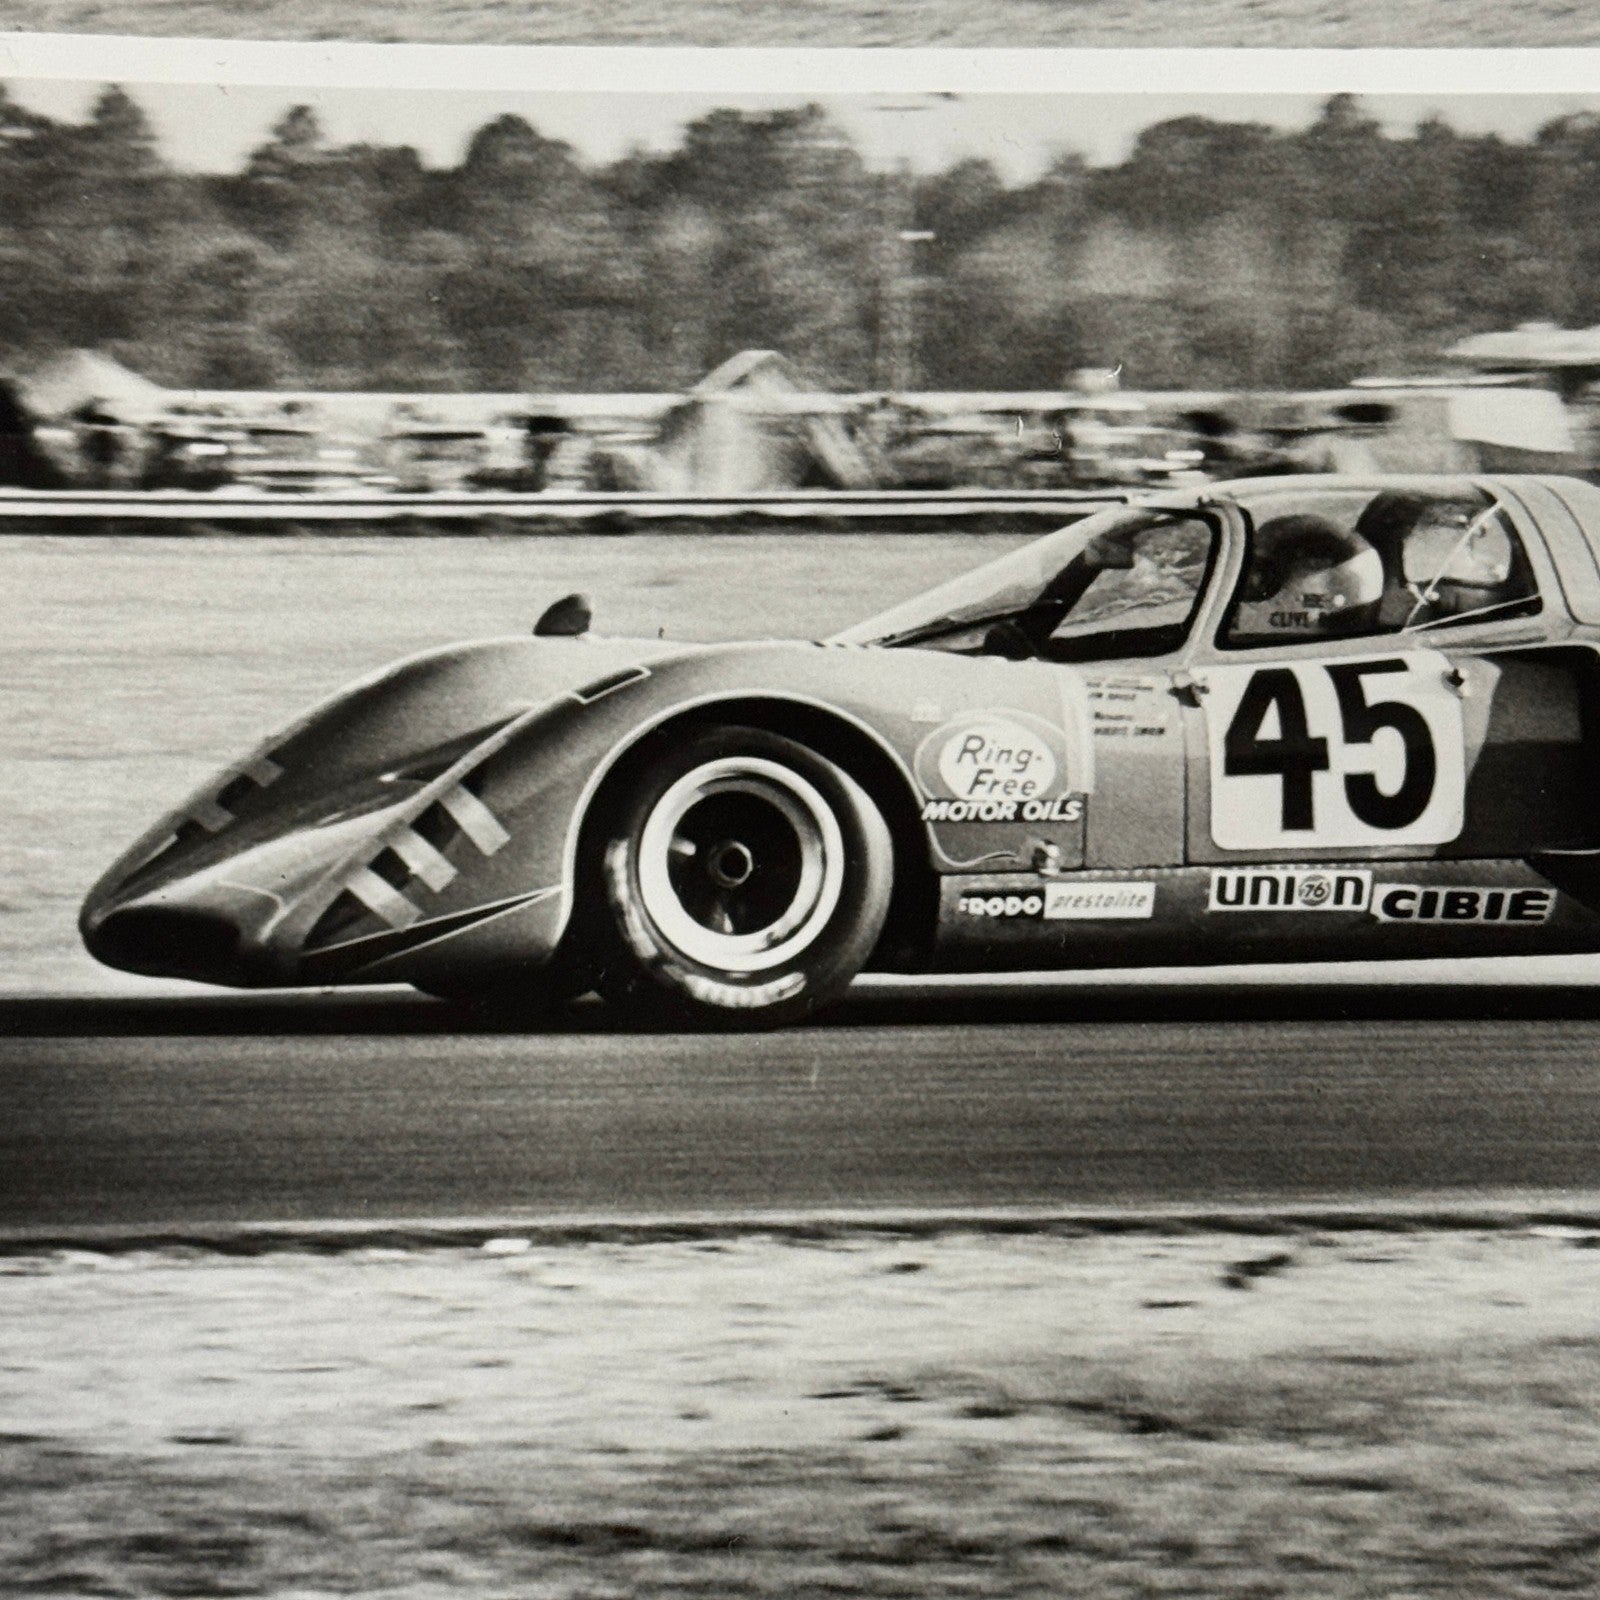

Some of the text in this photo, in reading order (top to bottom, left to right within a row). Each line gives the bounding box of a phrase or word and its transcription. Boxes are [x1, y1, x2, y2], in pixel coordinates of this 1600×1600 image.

[956, 734, 1043, 773] Ring-
[1224, 658, 1437, 831] 45
[967, 768, 1037, 796] Free
[921, 799, 1083, 821] MOTOR OILS
[1050, 890, 1148, 911] prestolite
